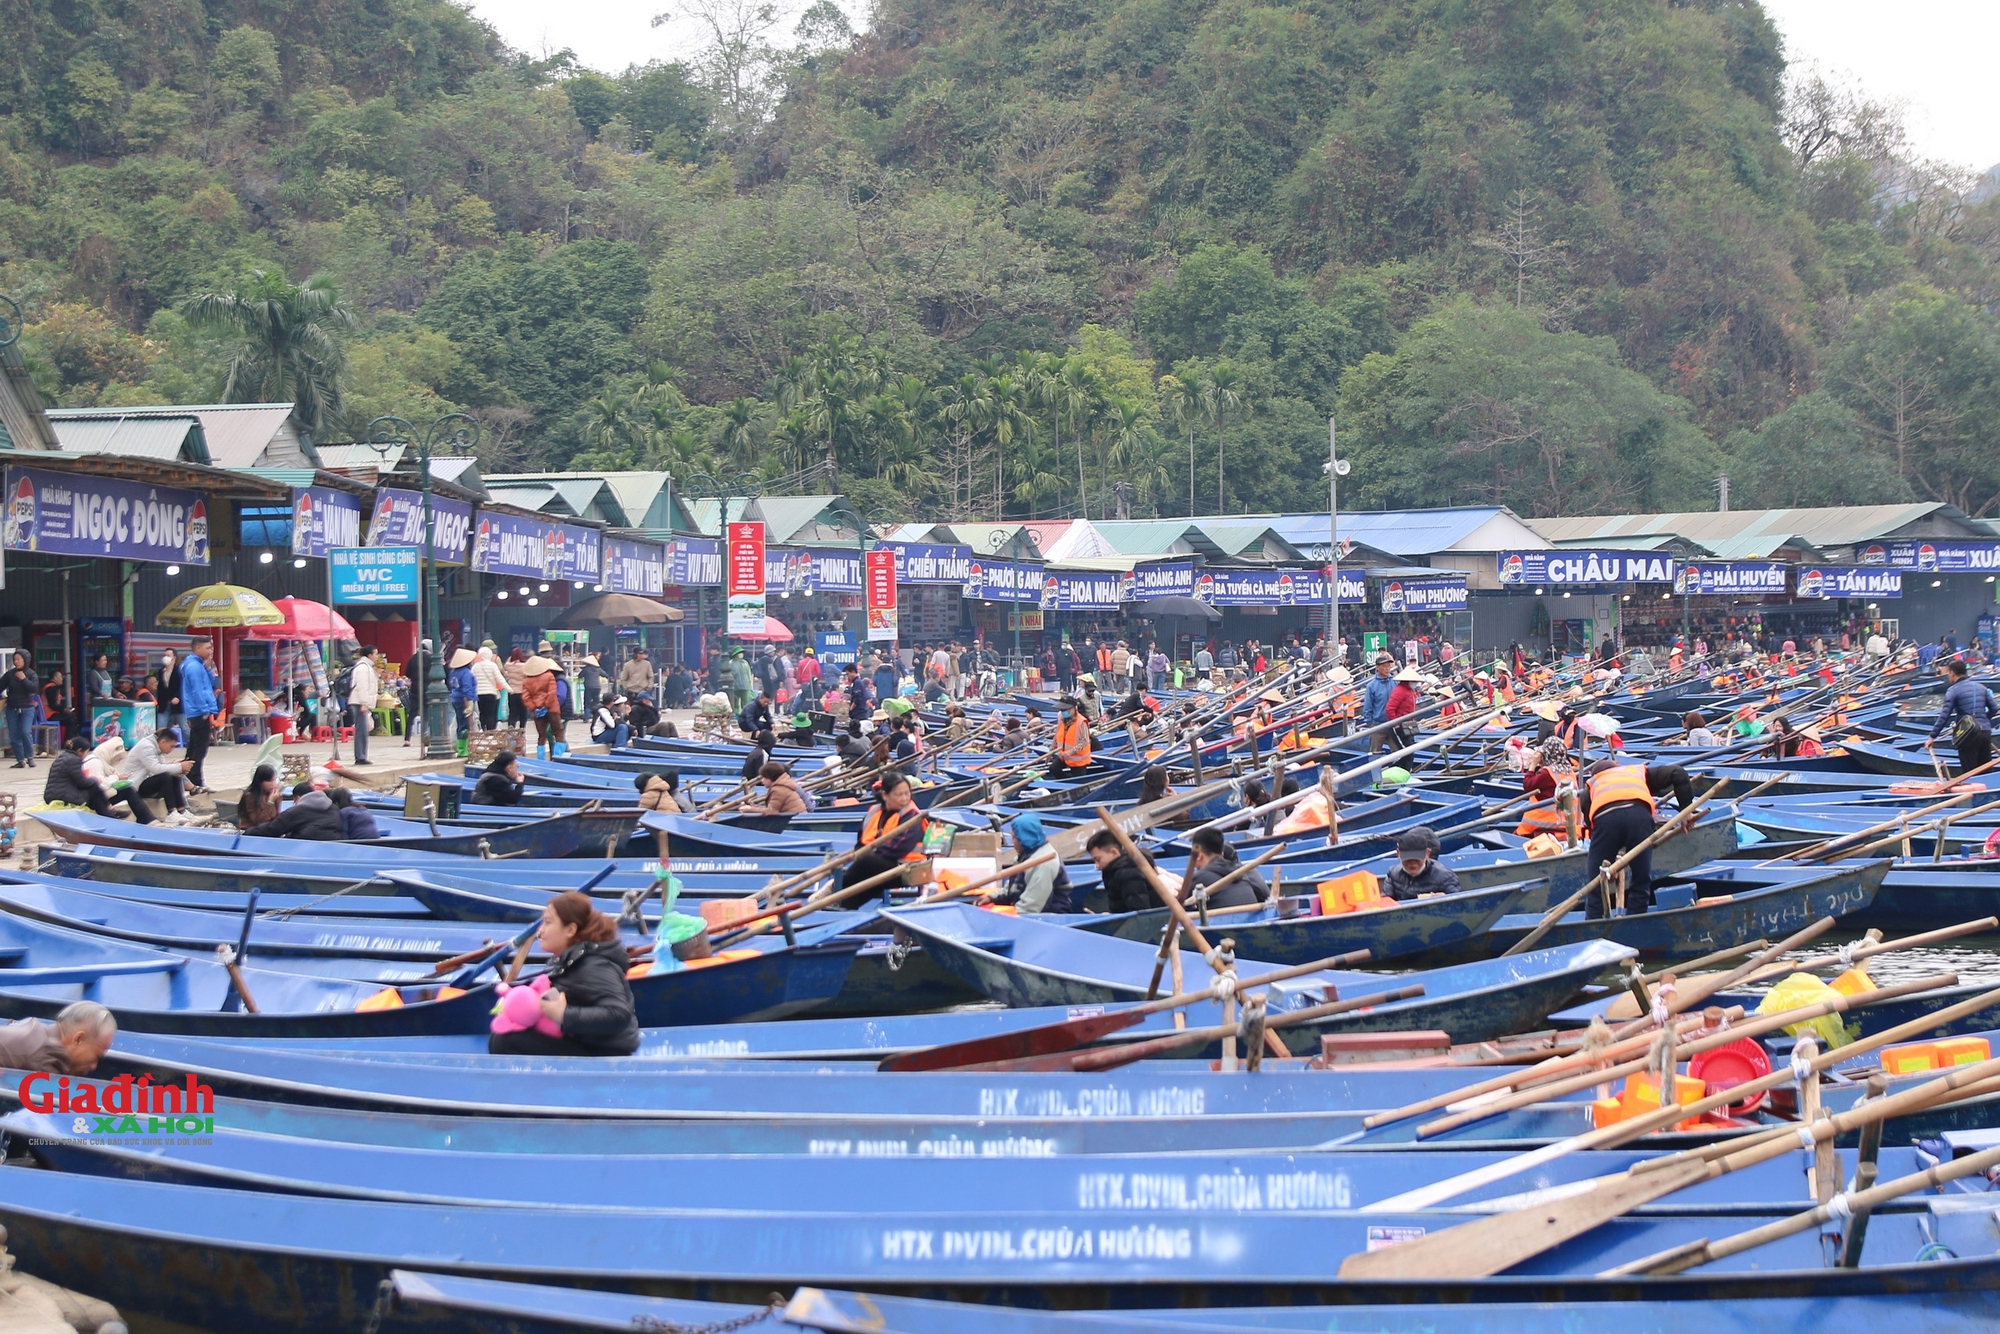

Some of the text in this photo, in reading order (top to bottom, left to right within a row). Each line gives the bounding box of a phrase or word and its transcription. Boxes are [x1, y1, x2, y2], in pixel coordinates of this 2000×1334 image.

[17, 501, 35, 517] PEPSI
[73, 492, 130, 553] NGỌC
[132, 488, 185, 549] ĐÔNG
[403, 496, 428, 544] BÍC
[433, 511, 470, 559] NGỌC
[500, 524, 528, 567] HOÀNG
[528, 528, 544, 569] THÁI
[1890, 548, 1915, 557] XUÂN
[334, 549, 416, 567] NHÀ VỆ SINH CÔNG CỘNG
[908, 548, 937, 579] CHIẾN
[938, 547, 970, 579] THẮNG
[1548, 553, 1620, 582] CHÂU
[1626, 558, 1673, 581] MAI
[357, 568, 393, 582] WC
[820, 558, 848, 584] MINH
[1024, 571, 1043, 590] ANH
[1145, 567, 1192, 588] HOÀNG ANH
[1714, 564, 1786, 586] HẢI HUYỀN
[1837, 569, 1867, 592] TẤN
[366, 582, 380, 592] PHÍ
[1070, 575, 1120, 603] HOA NHÀI
[1215, 578, 1280, 596] BA TUYẾN CÀ PHÊ
[1310, 579, 1324, 599] LÝ
[1405, 587, 1466, 604] TÍNH PHƯƠNG
[1010, 615, 1024, 627] HA
[1025, 613, 1042, 626] NHÀI
[825, 633, 846, 645] NHÀ
[833, 652, 855, 663] SINH
[1265, 1170, 1351, 1210] HƯƠNG
[883, 1230, 934, 1259] HTX
[1099, 1225, 1192, 1259] HƯƠNG
